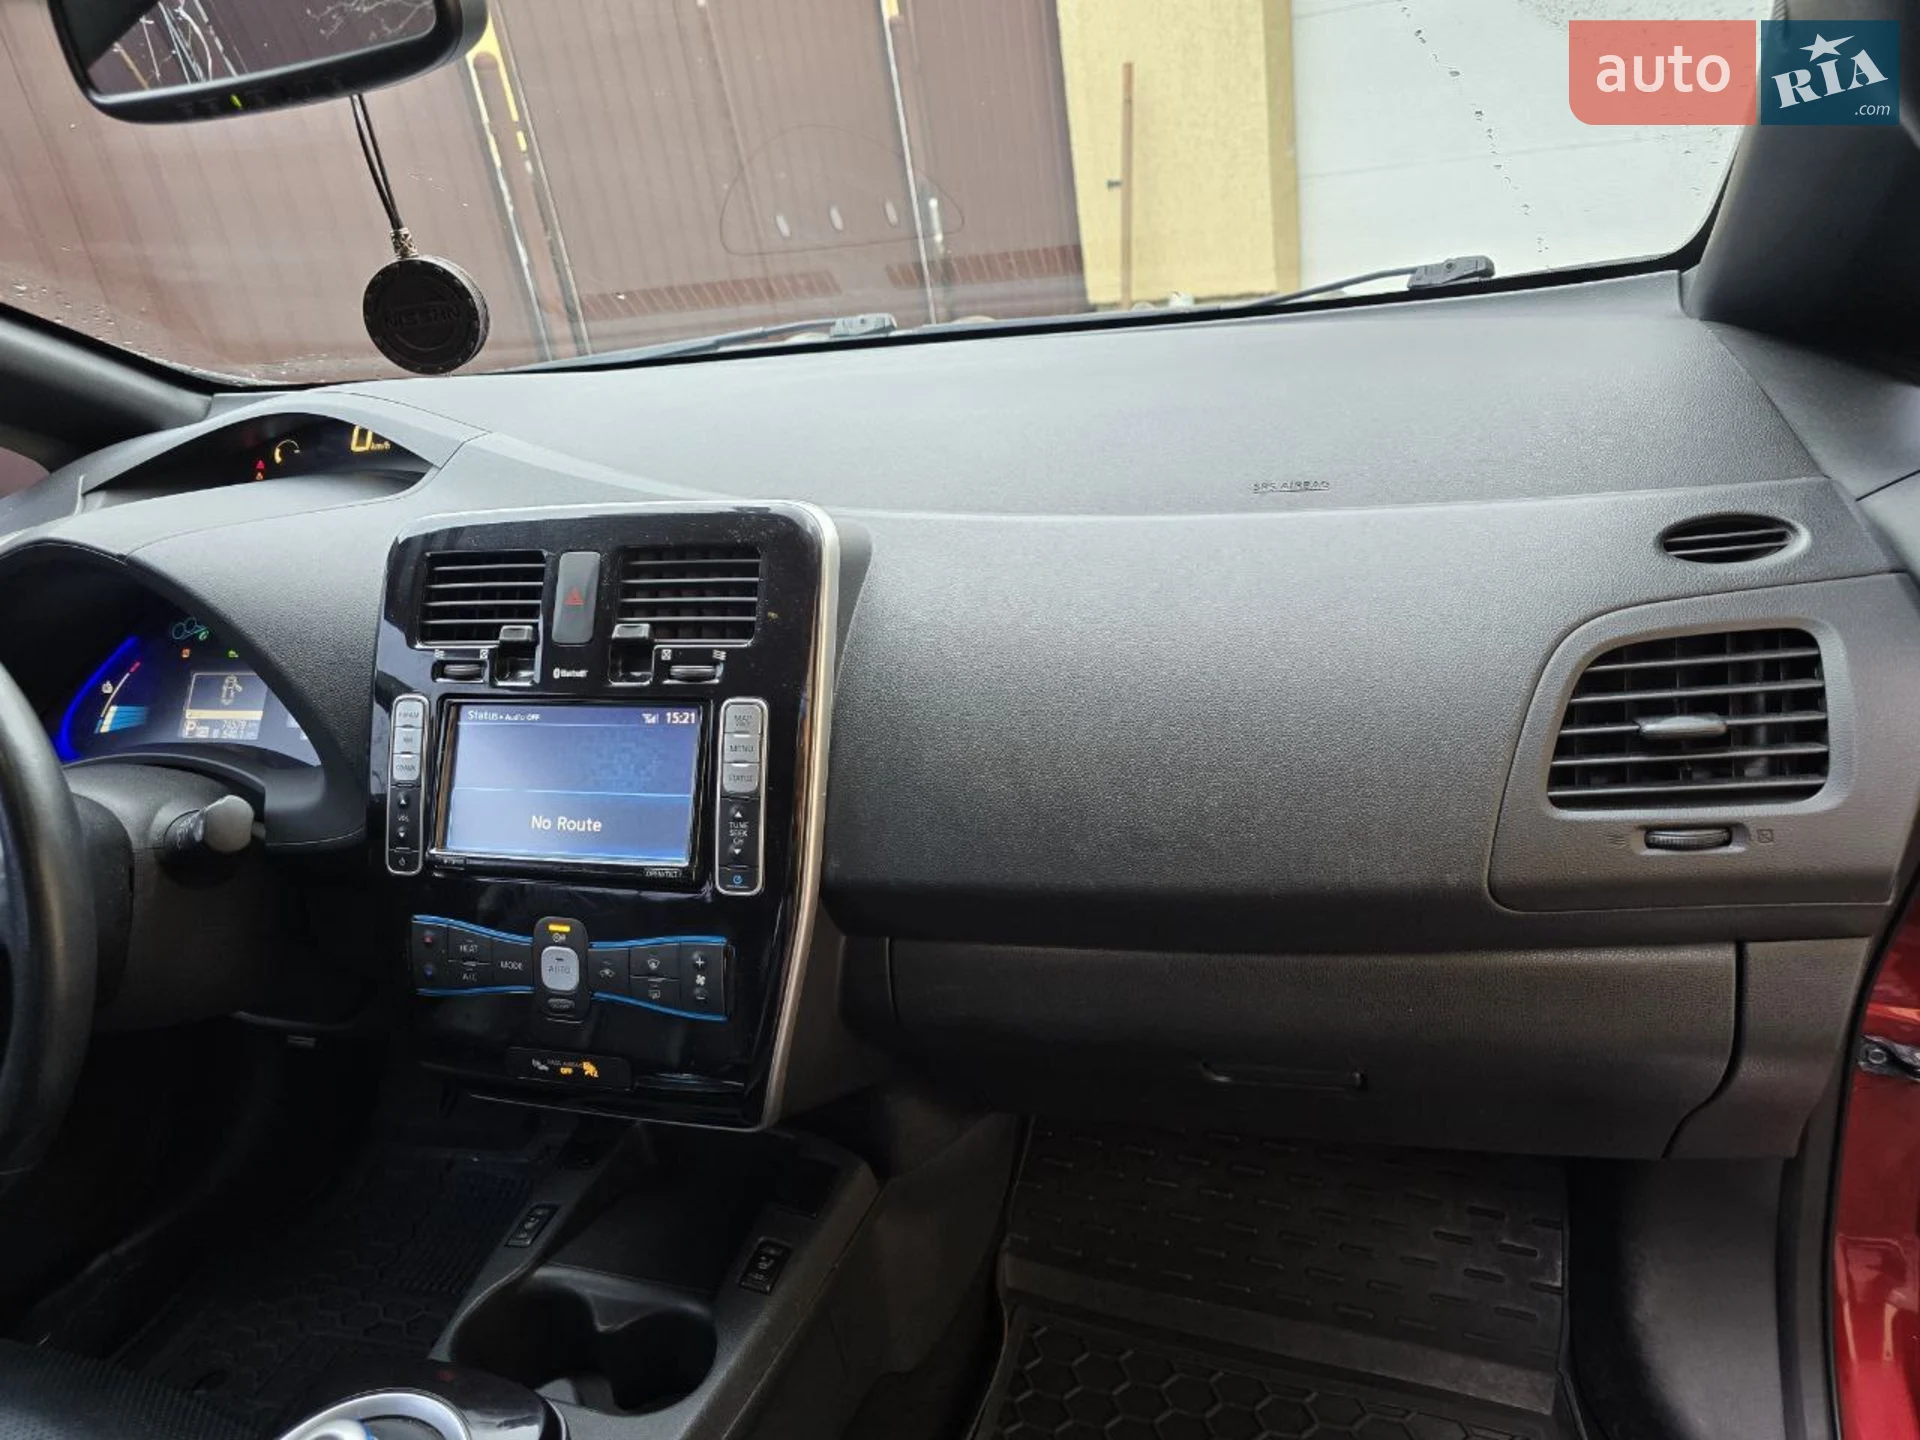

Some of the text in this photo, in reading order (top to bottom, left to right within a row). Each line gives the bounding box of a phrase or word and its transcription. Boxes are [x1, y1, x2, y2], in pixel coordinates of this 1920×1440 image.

[1281, 480, 1330, 491] AIRBAG
[666, 711, 695, 724] 15:21
[531, 815, 602, 832] No Route
[500, 960, 523, 971] MODE
[548, 965, 571, 974] AUTO
